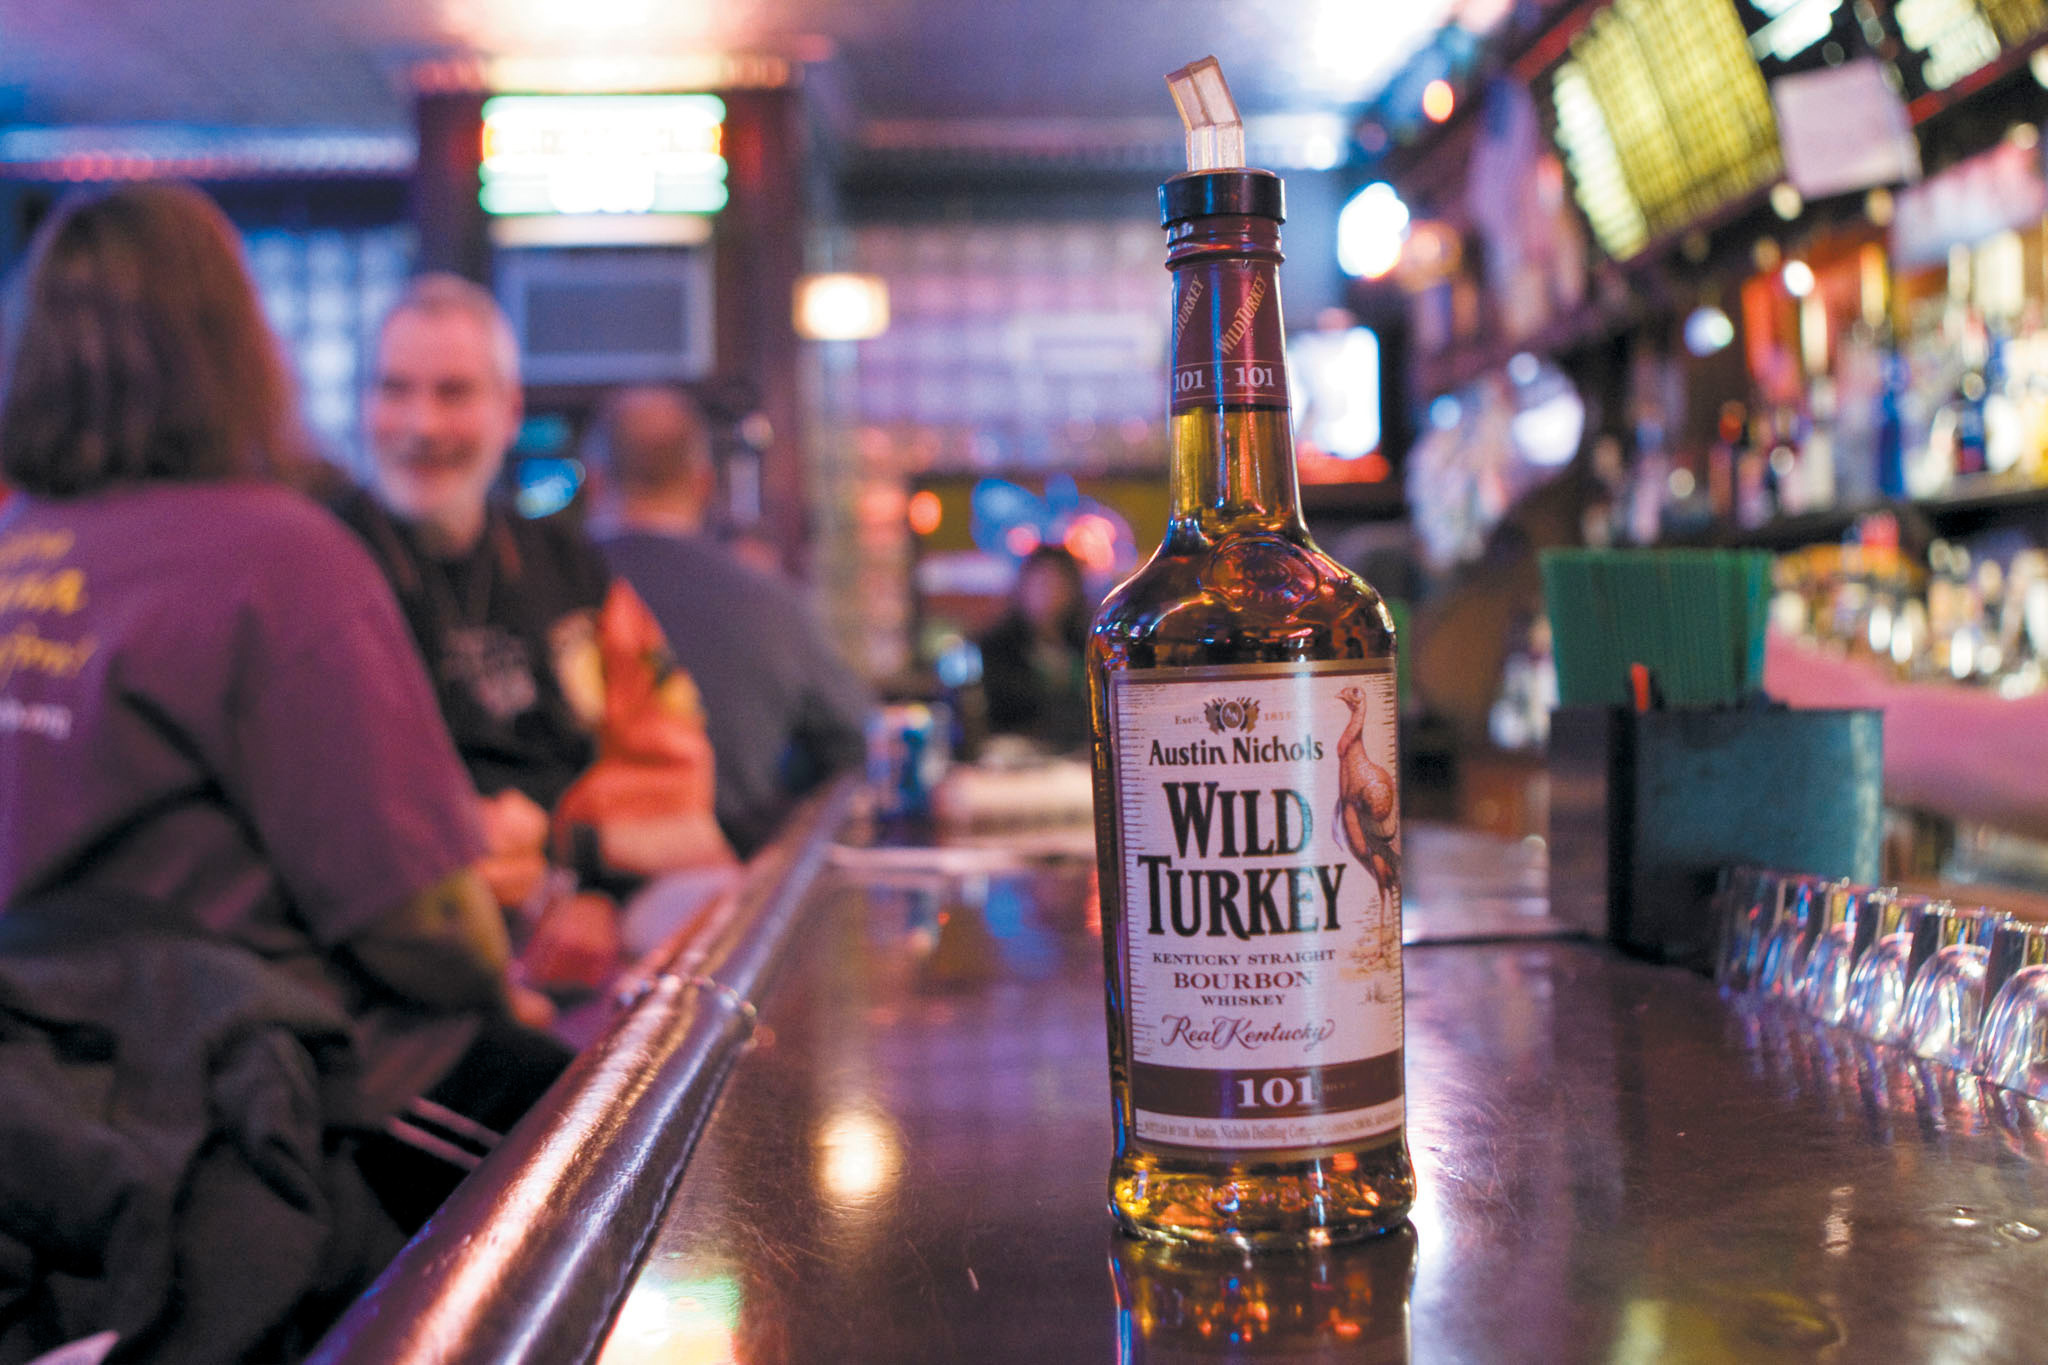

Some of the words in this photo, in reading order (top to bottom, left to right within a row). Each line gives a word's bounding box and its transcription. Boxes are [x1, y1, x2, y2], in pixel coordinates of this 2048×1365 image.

[1235, 366, 1275, 387] 101
[1149, 739, 1227, 766] Austin
[1233, 735, 1323, 764] Nichols
[1162, 781, 1313, 859] WILD
[1137, 855, 1347, 940] TURKEY
[1152, 952, 1241, 965] KENTUCKY
[1248, 949, 1337, 964] STRAIGHT
[1173, 969, 1313, 990] BOURBON
[1201, 994, 1287, 1007] WHISKEY
[1161, 1015, 1221, 1050] Real
[1212, 1015, 1336, 1052] Kentucky
[1237, 1076, 1320, 1108] 101
